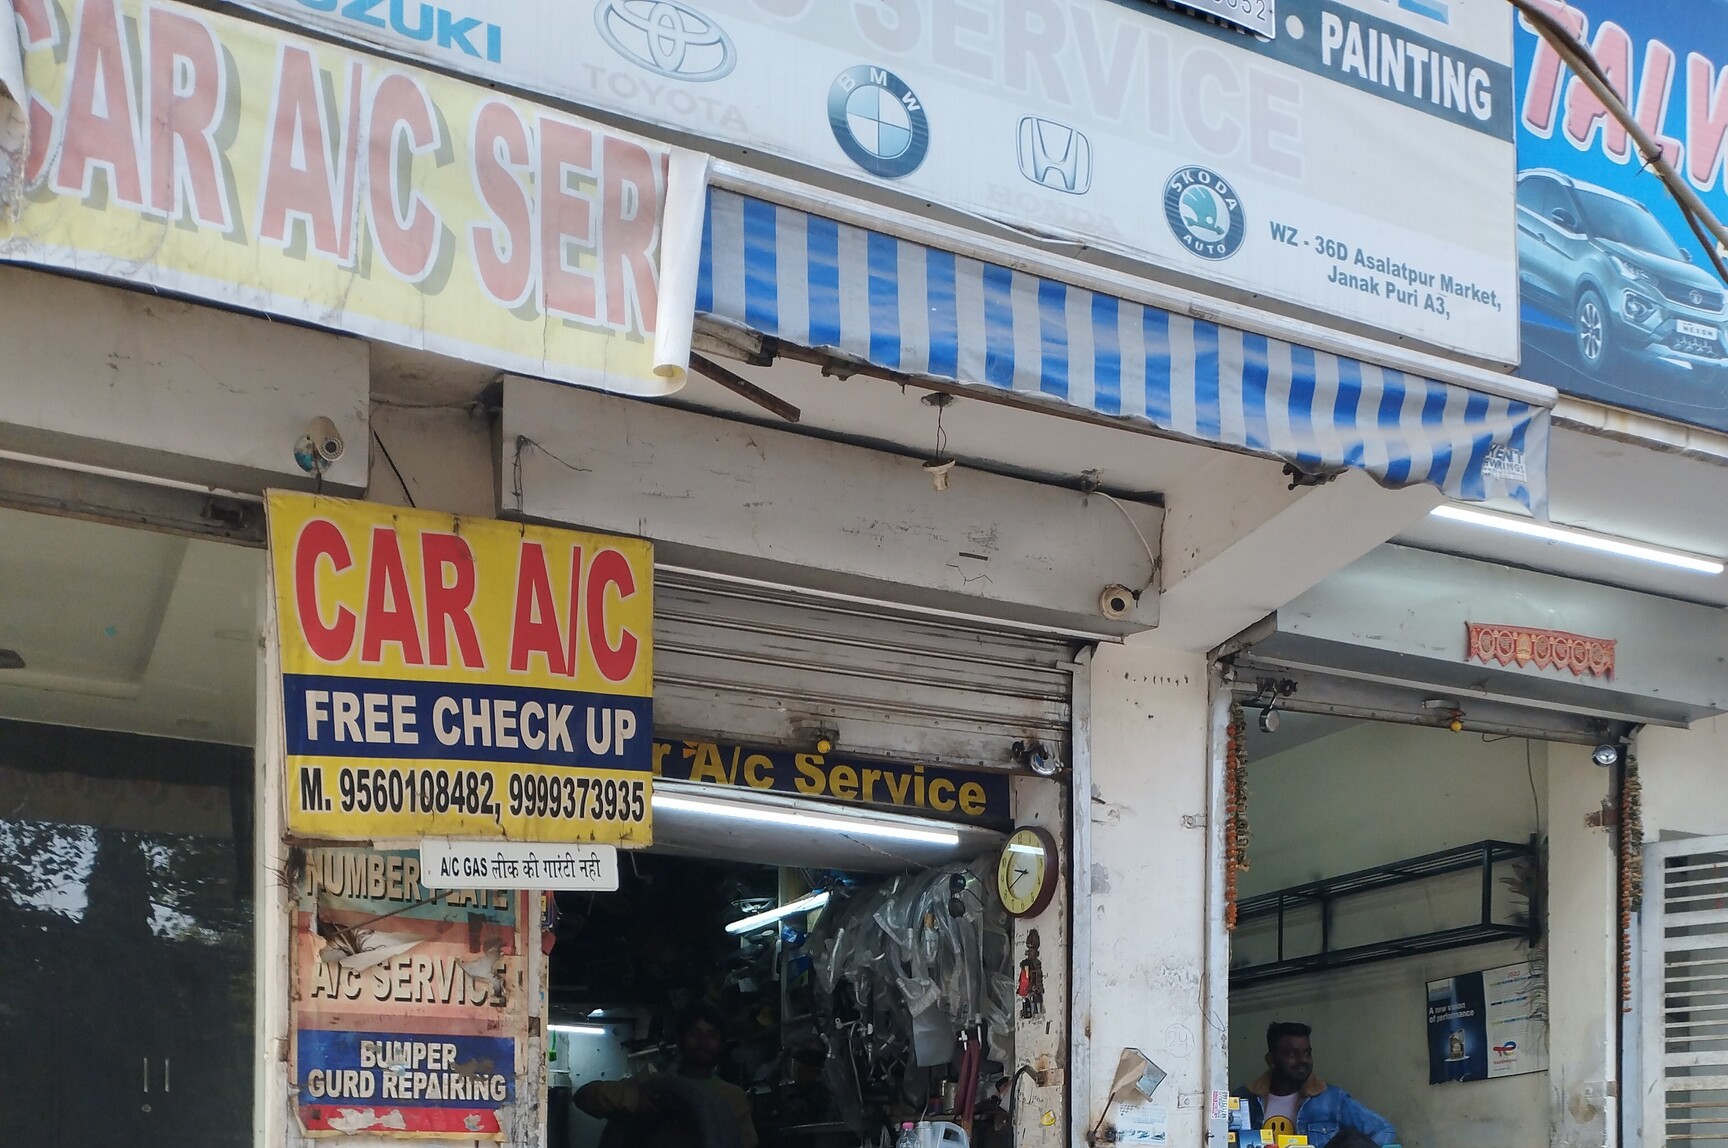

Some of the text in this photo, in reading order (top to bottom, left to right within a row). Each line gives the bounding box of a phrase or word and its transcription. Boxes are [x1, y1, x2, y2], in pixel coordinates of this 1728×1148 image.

[297, 0, 501, 64] ZUKI
[839, 66, 921, 113] BMW
[1322, 11, 1492, 121] PAINTING
[582, 63, 748, 132] TOYOTA
[258, 44, 440, 282] A/C
[470, 100, 669, 334] SER
[1171, 170, 1238, 212] SKODA
[1183, 233, 1227, 254] AUTO
[1269, 220, 1299, 247] WZ
[1314, 235, 1348, 262] 36D
[1353, 248, 1436, 288] Asalatpur
[1440, 273, 1502, 312] Market,
[1327, 265, 1451, 320] Janak Puri A3,
[295, 519, 638, 681] CAR A/C
[305, 690, 636, 756] FREE CHECK UP
[300, 767, 645, 823] M. 9560108482, 9999373935
[688, 741, 775, 790] A/c
[793, 752, 987, 816] Service
[306, 850, 422, 902] NUMBER
[440, 856, 460, 877] A/C
[463, 857, 488, 878] GAS
[491, 852, 519, 880] लीक
[522, 851, 539, 879] की
[543, 851, 576, 879] गारंटी
[360, 1040, 457, 1070] BUMPER
[308, 1069, 507, 1101] GURD REPAIRING
